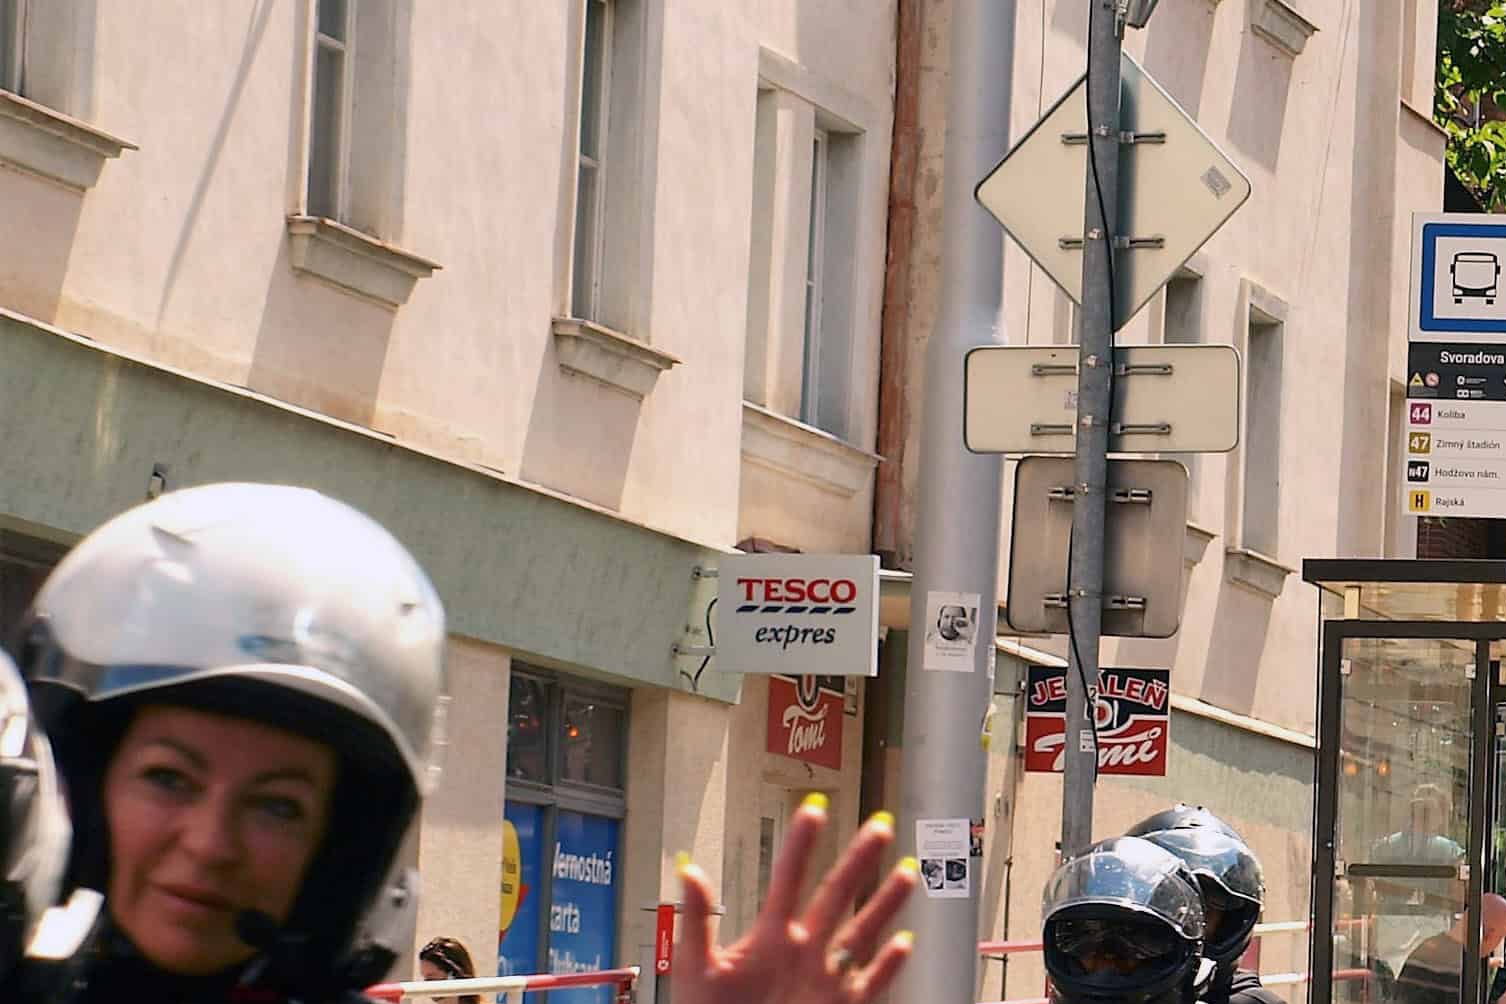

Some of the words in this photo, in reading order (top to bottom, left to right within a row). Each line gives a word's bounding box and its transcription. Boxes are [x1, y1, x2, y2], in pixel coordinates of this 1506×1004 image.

[1440, 352, 1504, 364] Svoradova
[1412, 407, 1430, 421] 44
[1437, 410, 1465, 419] Koliba
[1410, 436, 1429, 449] 47
[1436, 440, 1464, 450] Zimný
[1435, 468, 1475, 478] Hodžovo
[1415, 494, 1424, 507] H
[1436, 497, 1464, 508] Rajská
[737, 578, 856, 603] TESCO
[755, 624, 835, 650] expres
[783, 703, 829, 754] Tomi
